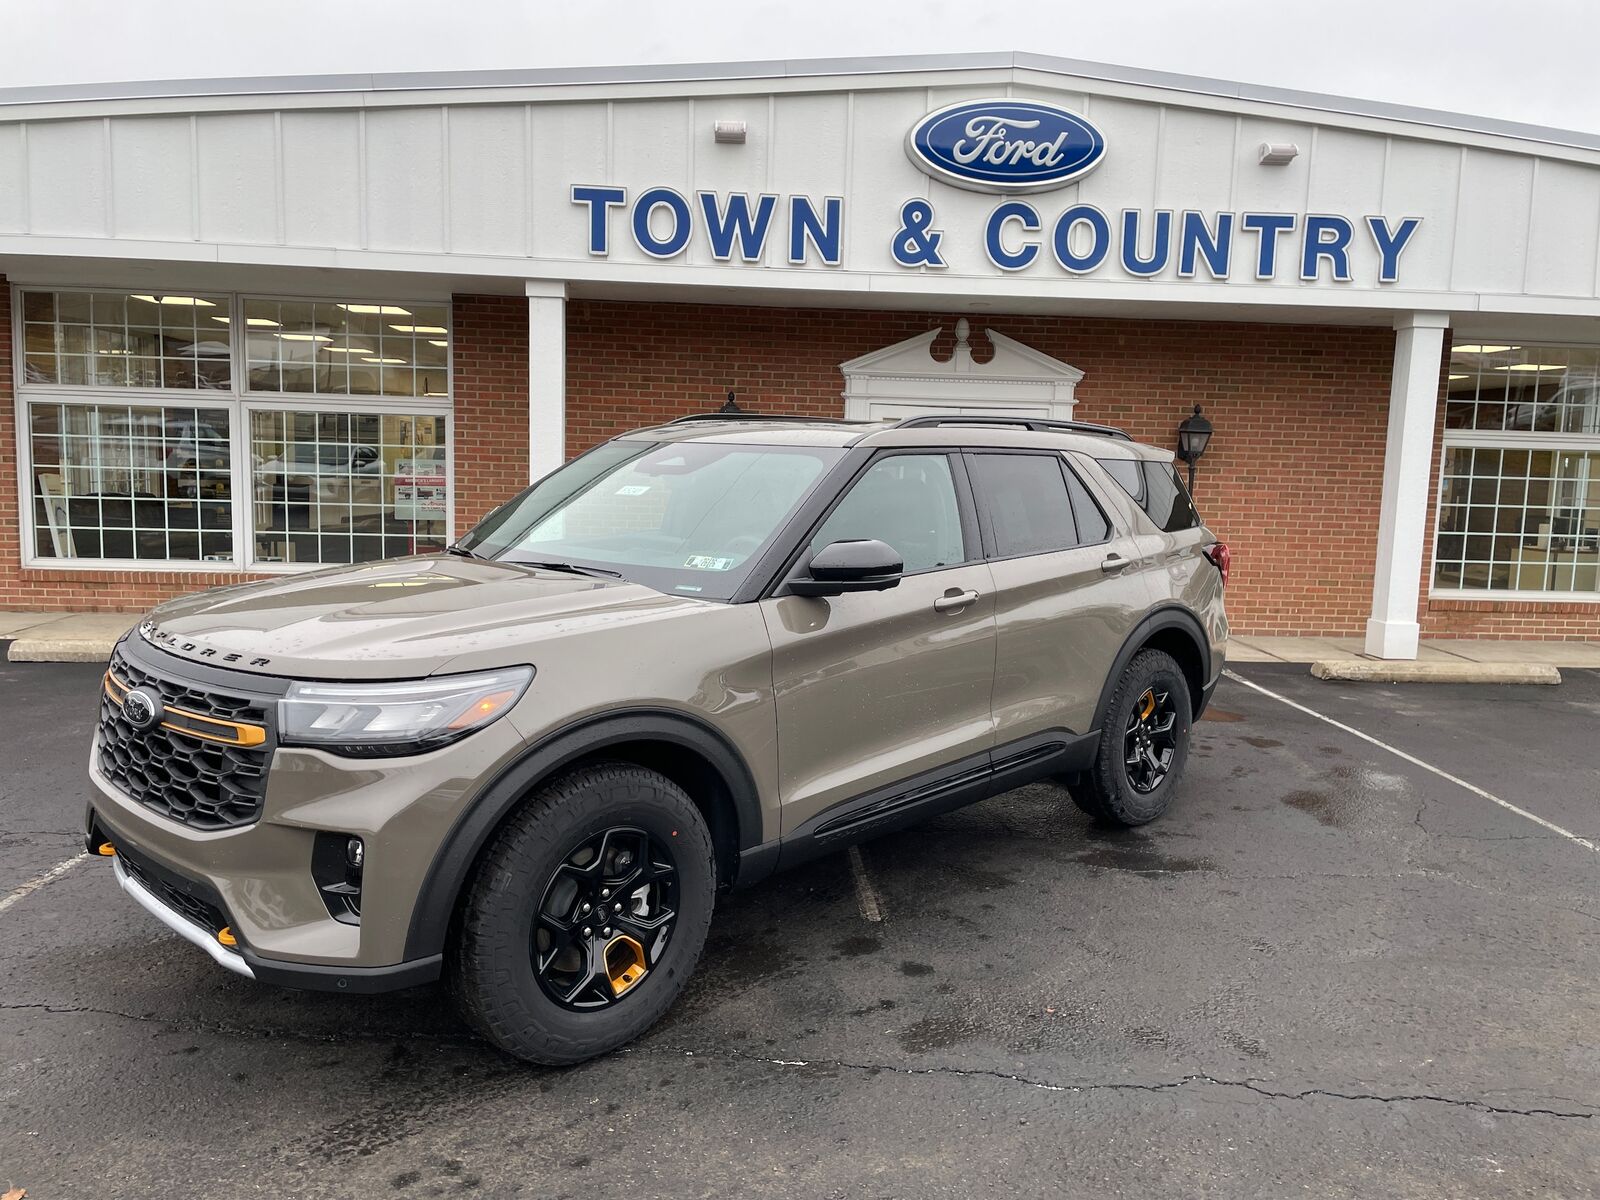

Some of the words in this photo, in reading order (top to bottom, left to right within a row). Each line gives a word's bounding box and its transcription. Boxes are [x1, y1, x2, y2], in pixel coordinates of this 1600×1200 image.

[953, 115, 1069, 167] Ford
[570, 184, 844, 266] TOWN
[891, 197, 949, 269] &
[984, 200, 1424, 283] COUNTRY
